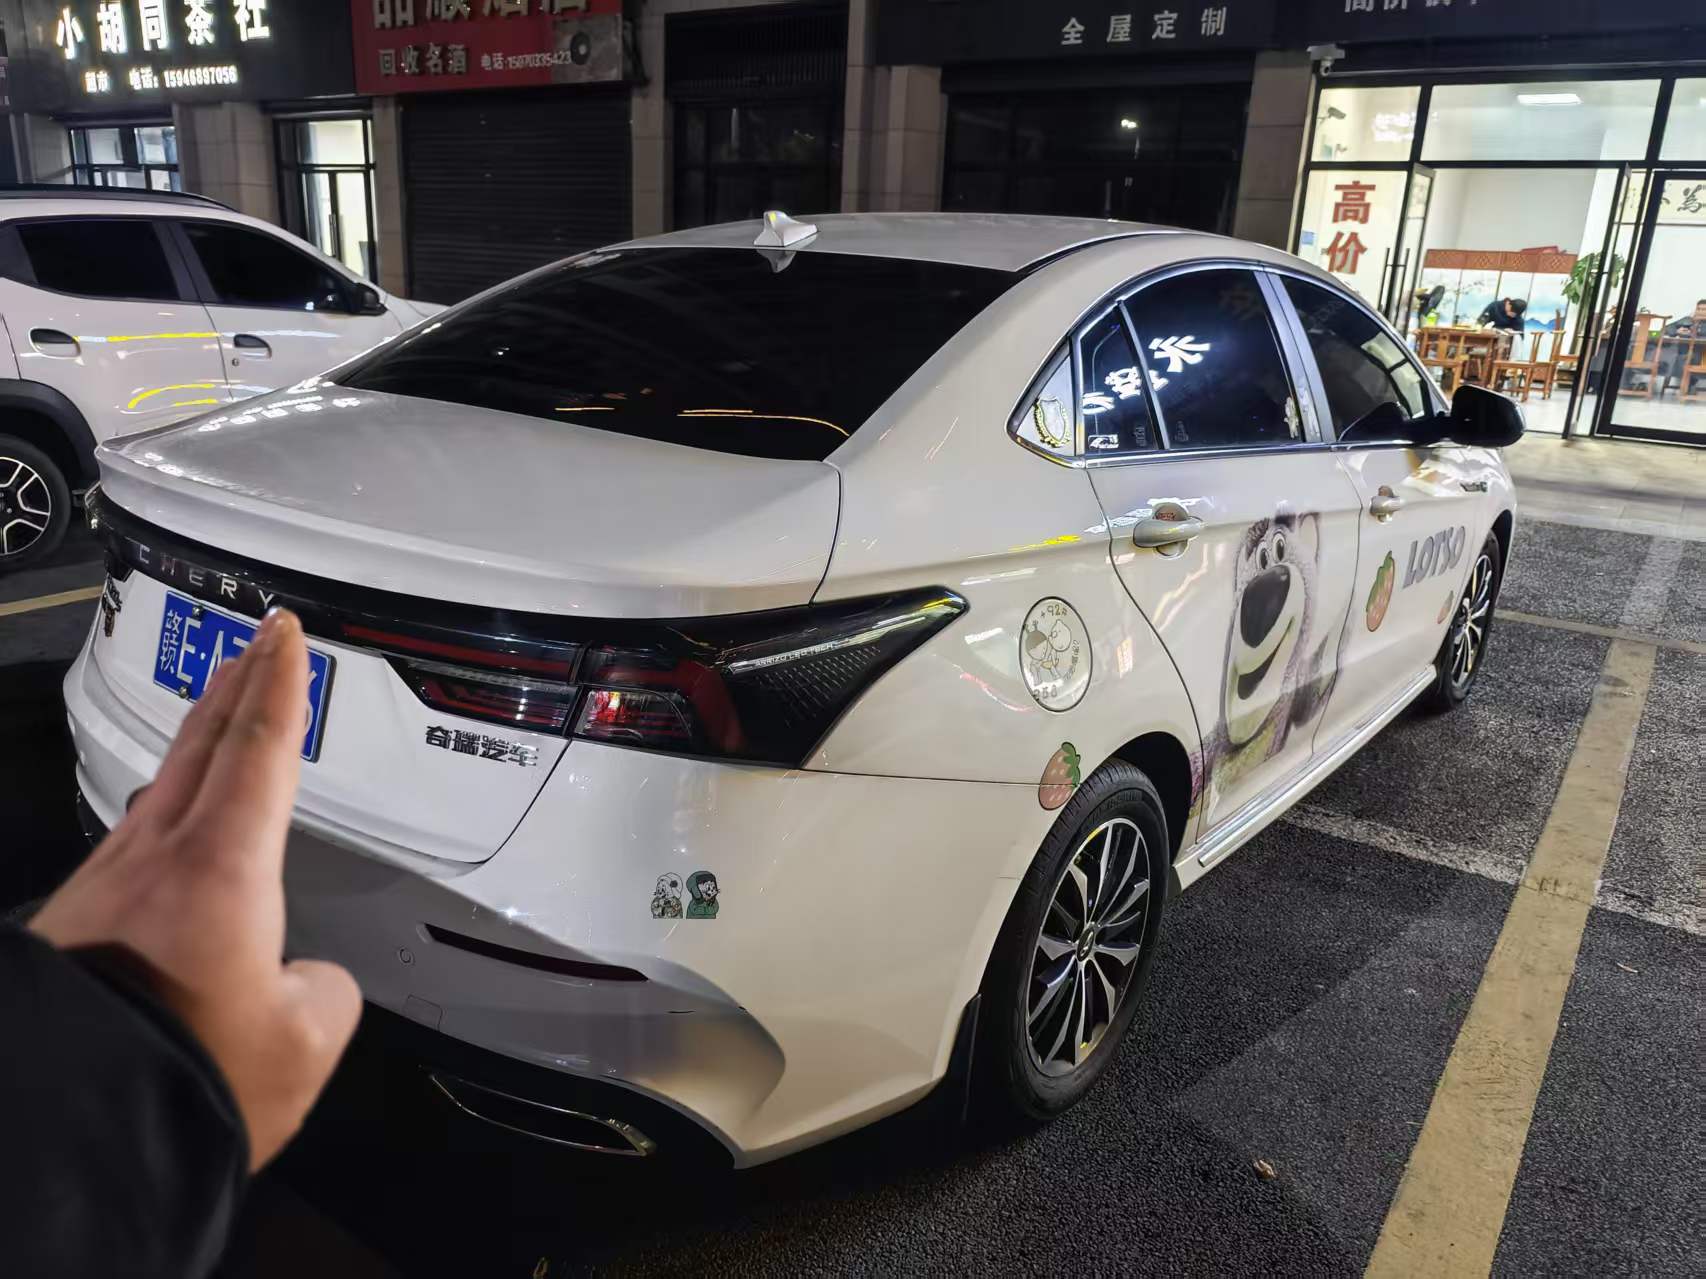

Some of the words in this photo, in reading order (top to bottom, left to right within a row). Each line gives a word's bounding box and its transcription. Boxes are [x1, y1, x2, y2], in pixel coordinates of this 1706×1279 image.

[56, 0, 270, 60] 小胡同茶社
[1061, 7, 1227, 45] 全屋定制
[379, 43, 467, 76] 回收名酒
[1327, 180, 1376, 275] 高价
[1402, 525, 1465, 589] LOTSO
[426, 725, 539, 767] 奇瑞汽车
